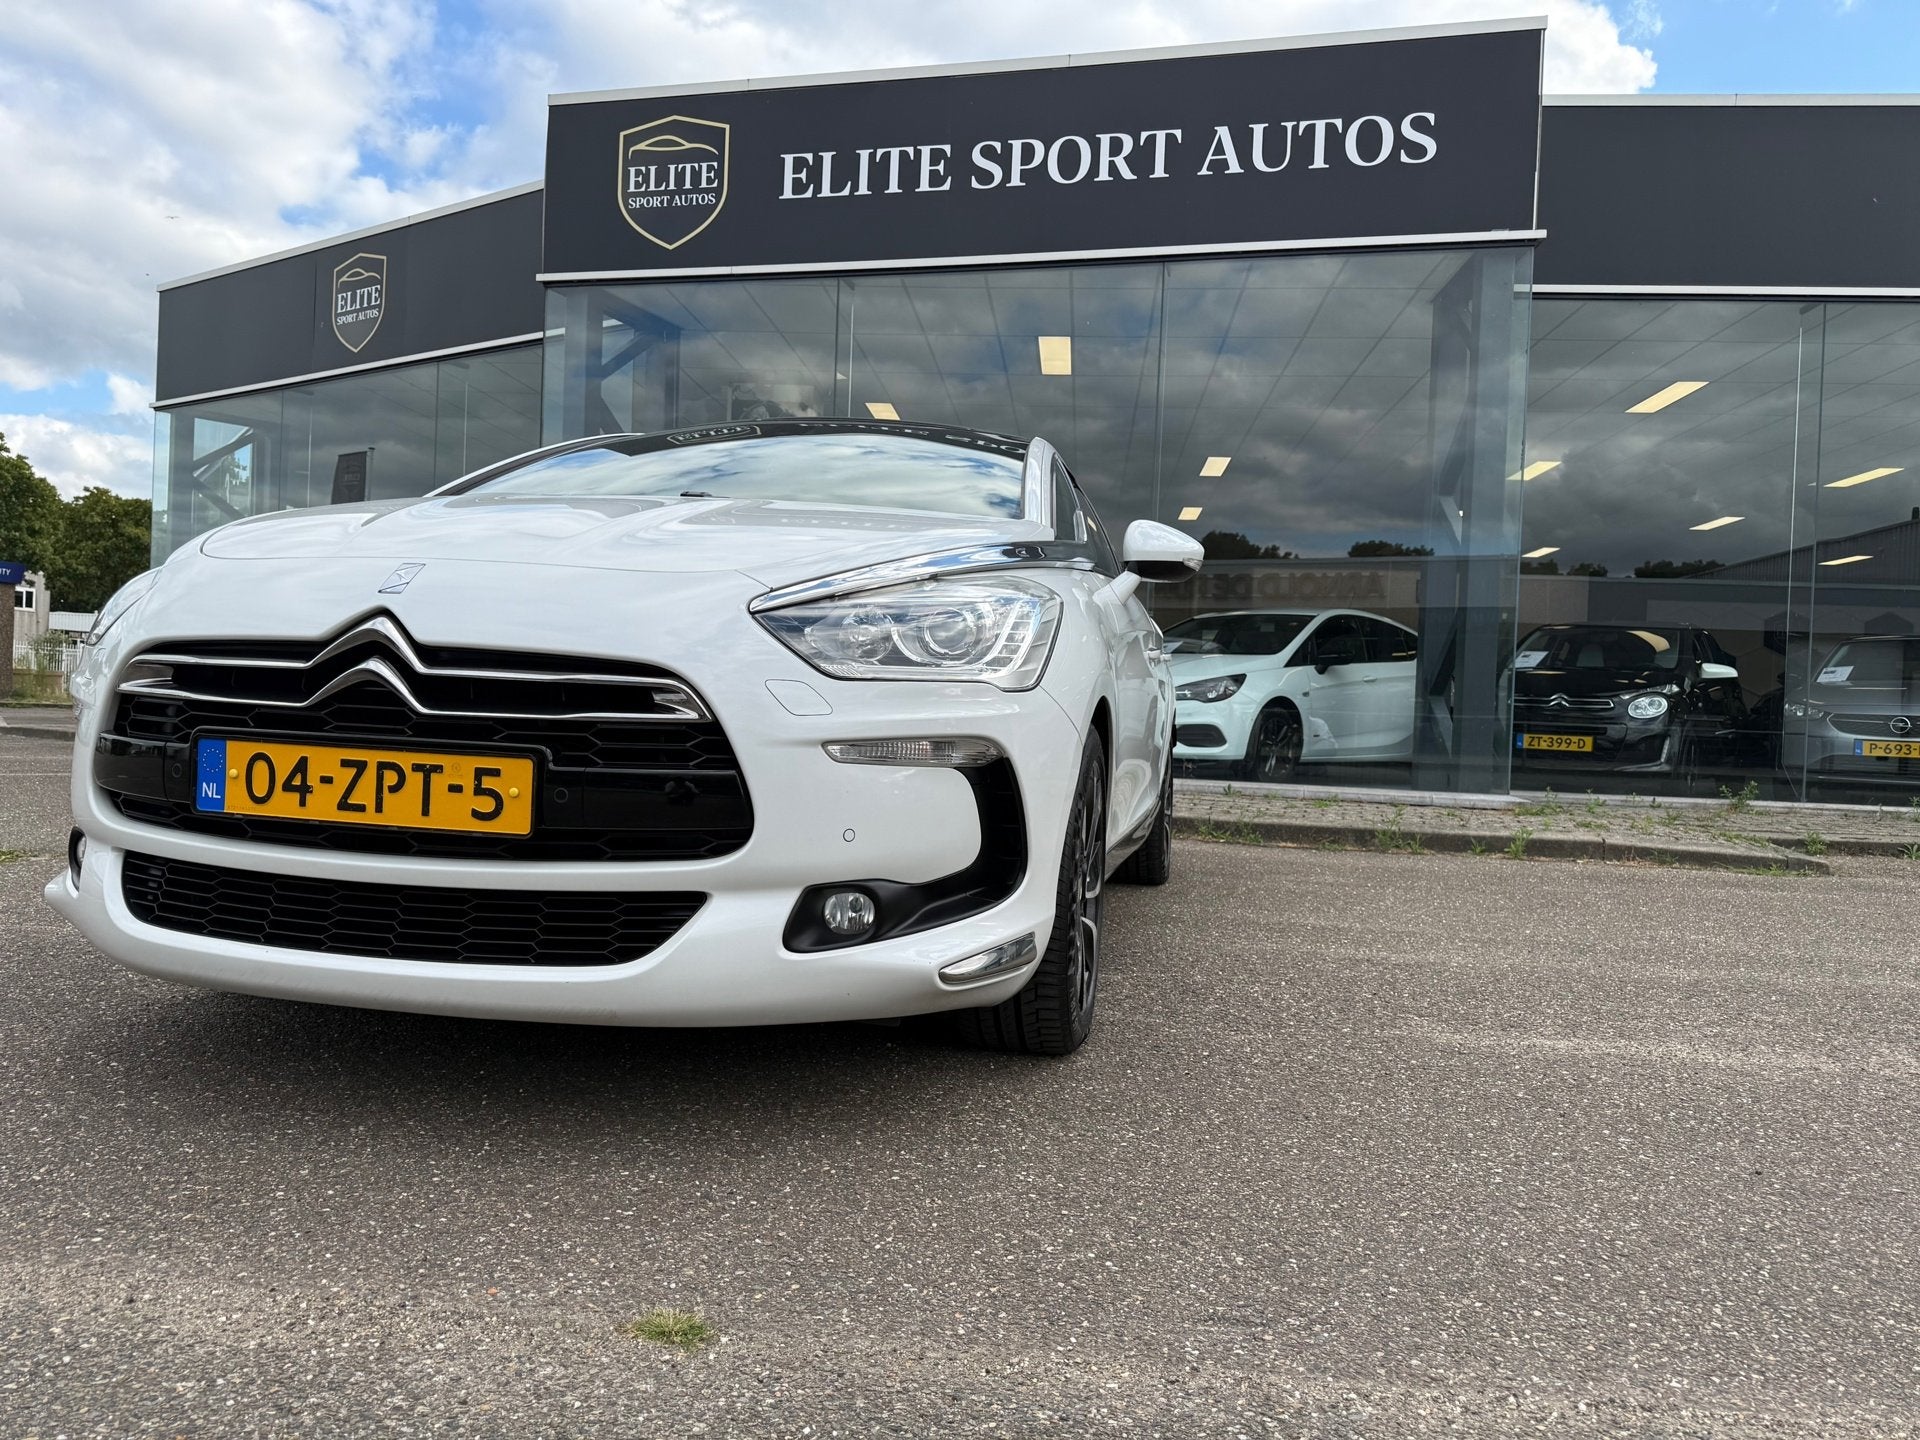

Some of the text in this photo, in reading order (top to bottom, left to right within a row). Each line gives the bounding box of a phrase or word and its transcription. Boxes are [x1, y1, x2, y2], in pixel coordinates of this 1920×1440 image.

[778, 111, 1437, 200] ELITE SPORT AUTOS
[626, 161, 719, 193] ELITE
[628, 193, 716, 209] SPORT AUTOS
[336, 284, 381, 314] ELITE
[336, 308, 380, 326] SPORT AUTOS
[1527, 735, 1587, 750] ZT-399-D
[1869, 742, 1920, 757] P-693-
[202, 781, 222, 799] NL
[244, 751, 505, 823] 04-ZPT-5
